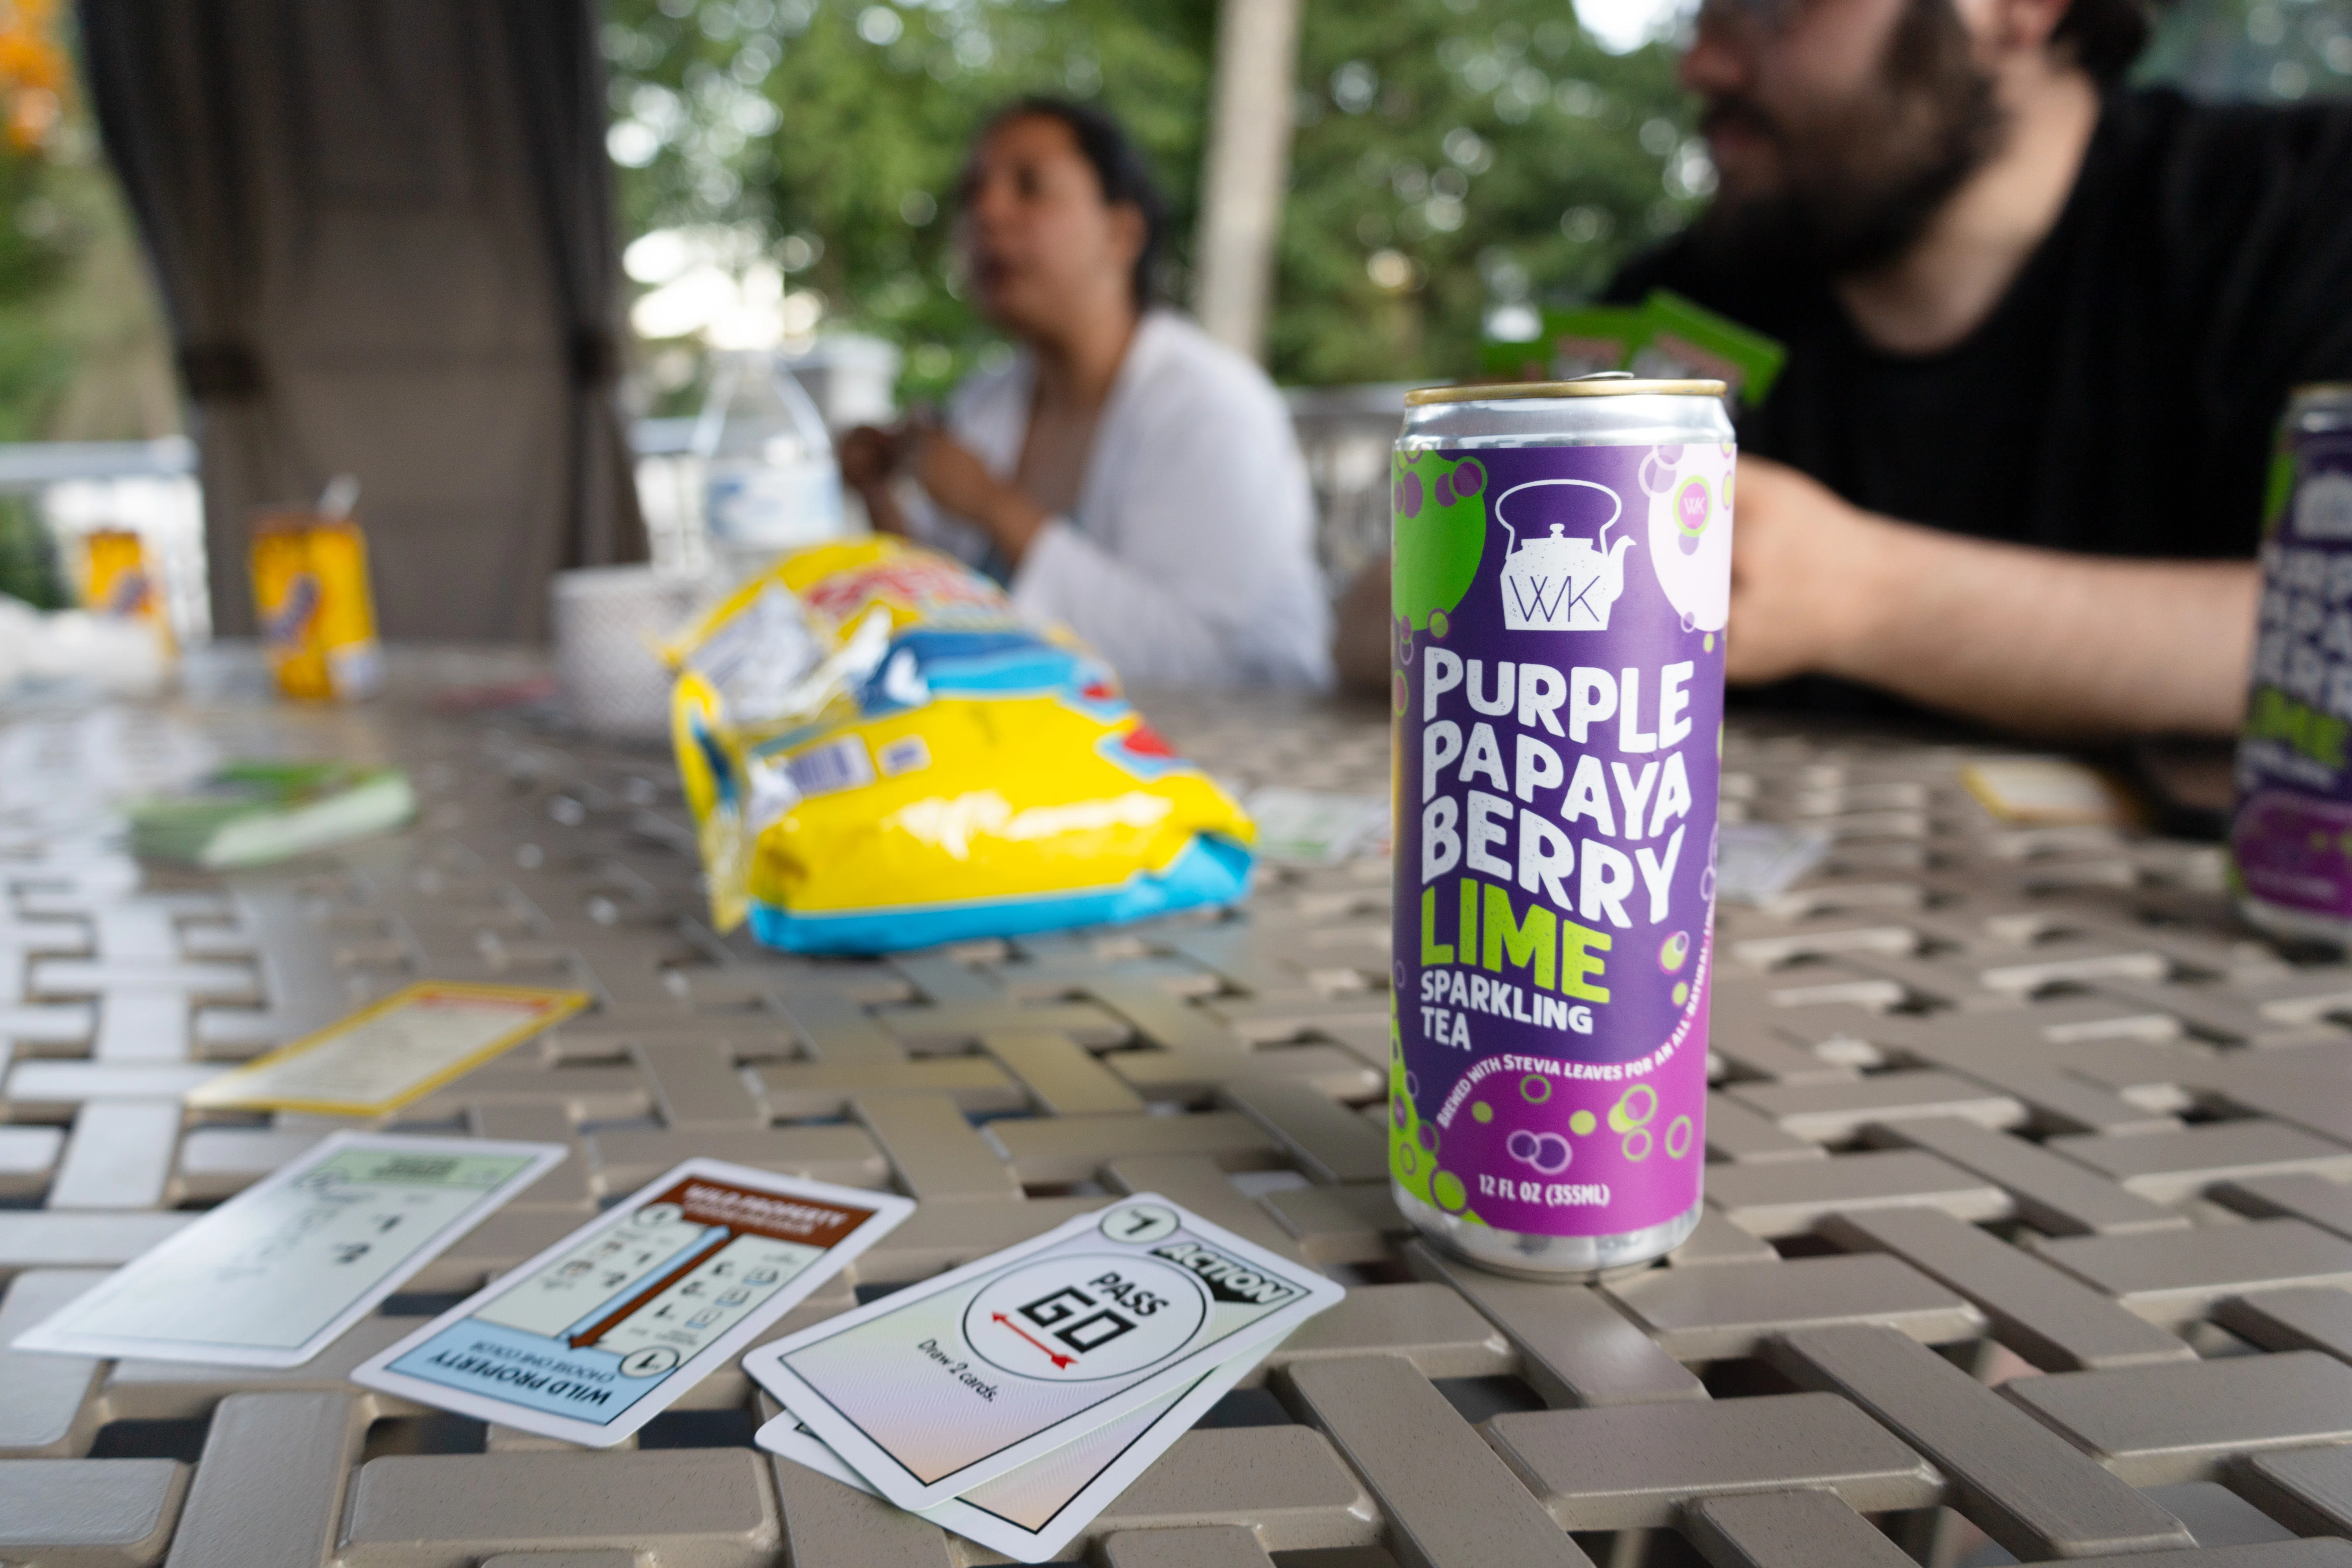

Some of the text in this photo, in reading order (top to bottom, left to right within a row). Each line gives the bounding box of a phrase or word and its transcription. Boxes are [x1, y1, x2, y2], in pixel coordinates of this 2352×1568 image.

[1684, 497, 1705, 515] WK
[1508, 575, 1601, 622] WK
[1423, 646, 1694, 754] PURPLE
[1423, 720, 1693, 841] PAPAYA
[1422, 791, 1687, 929] BERRY
[1421, 878, 1612, 1003] LIME
[1421, 970, 1593, 1034] SPARKLING
[1421, 1007, 1471, 1050] TEA
[1436, 1079, 1472, 1128] BREWED
[1467, 1056, 1502, 1083] WITH
[1502, 1053, 1560, 1076] STEVIA
[1564, 1062, 1622, 1080] LEAVES
[1625, 1057, 1652, 1079] FOR
[1654, 1042, 1674, 1066] AN
[1479, 1173, 1611, 1208] 12 FL OZ (355ML)
[1087, 1271, 1171, 1318] PASS
[1159, 1241, 1297, 1305] ACTION
[1016, 1284, 1138, 1354] GO
[428, 1349, 613, 1407] WILD PROPERTY
[917, 1338, 998, 1402] Draw 2 cards.
